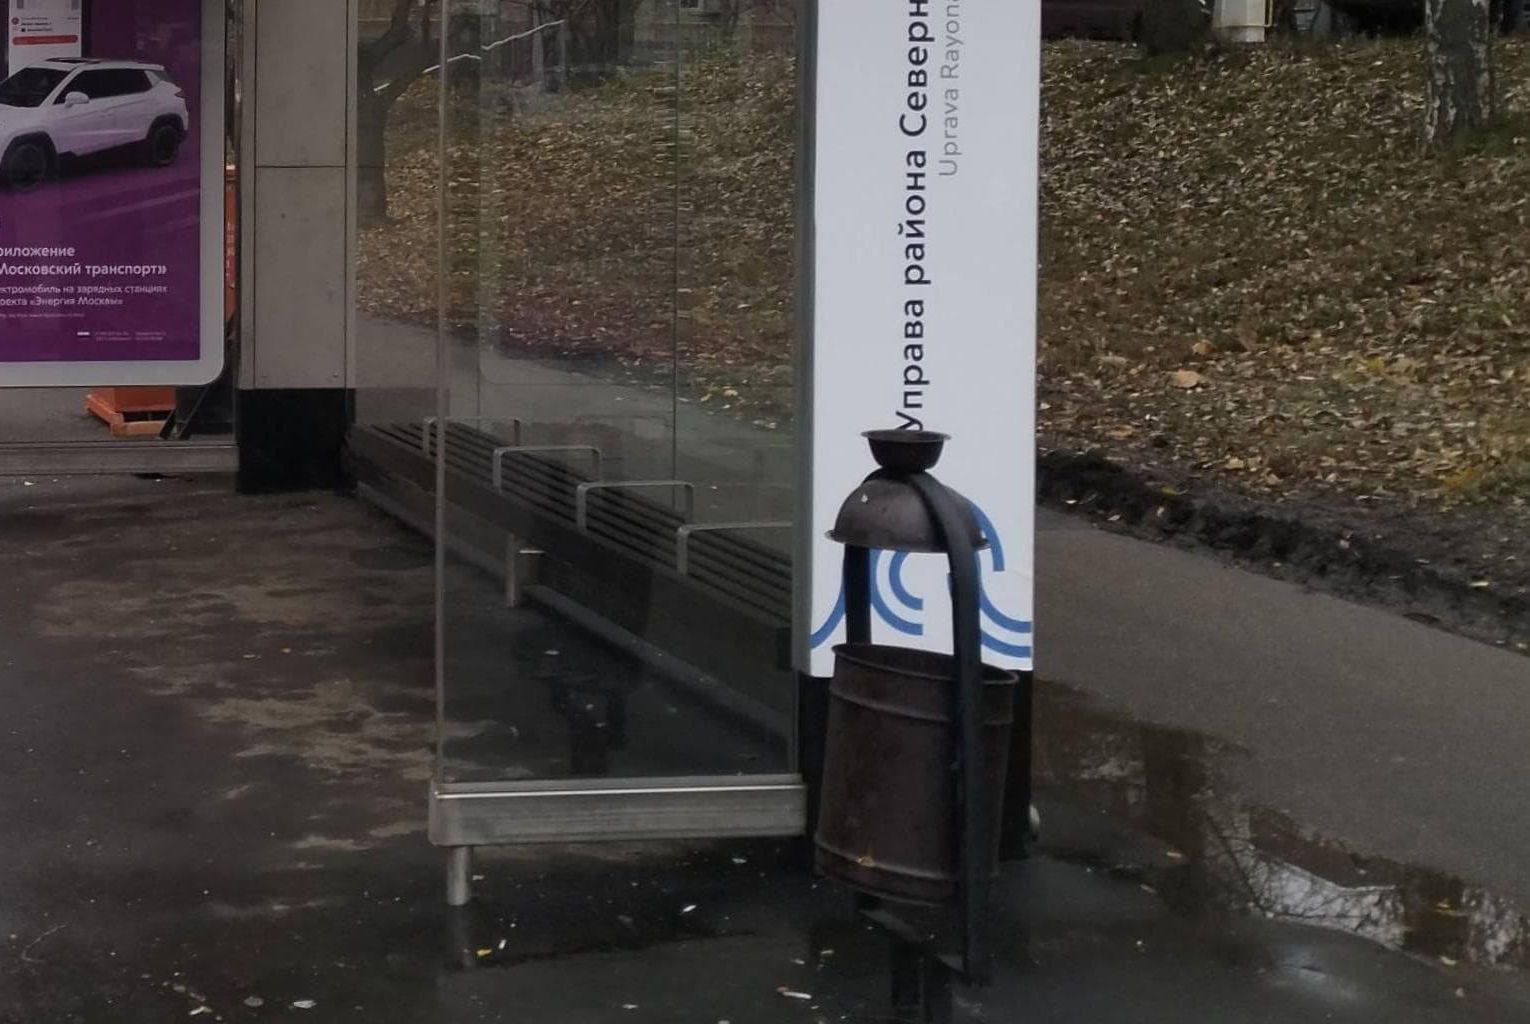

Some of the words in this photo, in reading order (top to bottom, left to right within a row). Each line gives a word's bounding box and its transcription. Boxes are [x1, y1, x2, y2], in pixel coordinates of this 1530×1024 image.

[939, 88, 962, 176] Uprava
[898, 150, 931, 285] района
[62, 286, 74, 294] на
[77, 285, 123, 295] зарядных
[124, 285, 168, 294] станциях
[85, 264, 167, 278] транспорт»
[29, 296, 76, 307] «Энергия
[896, 300, 930, 430] Управа
